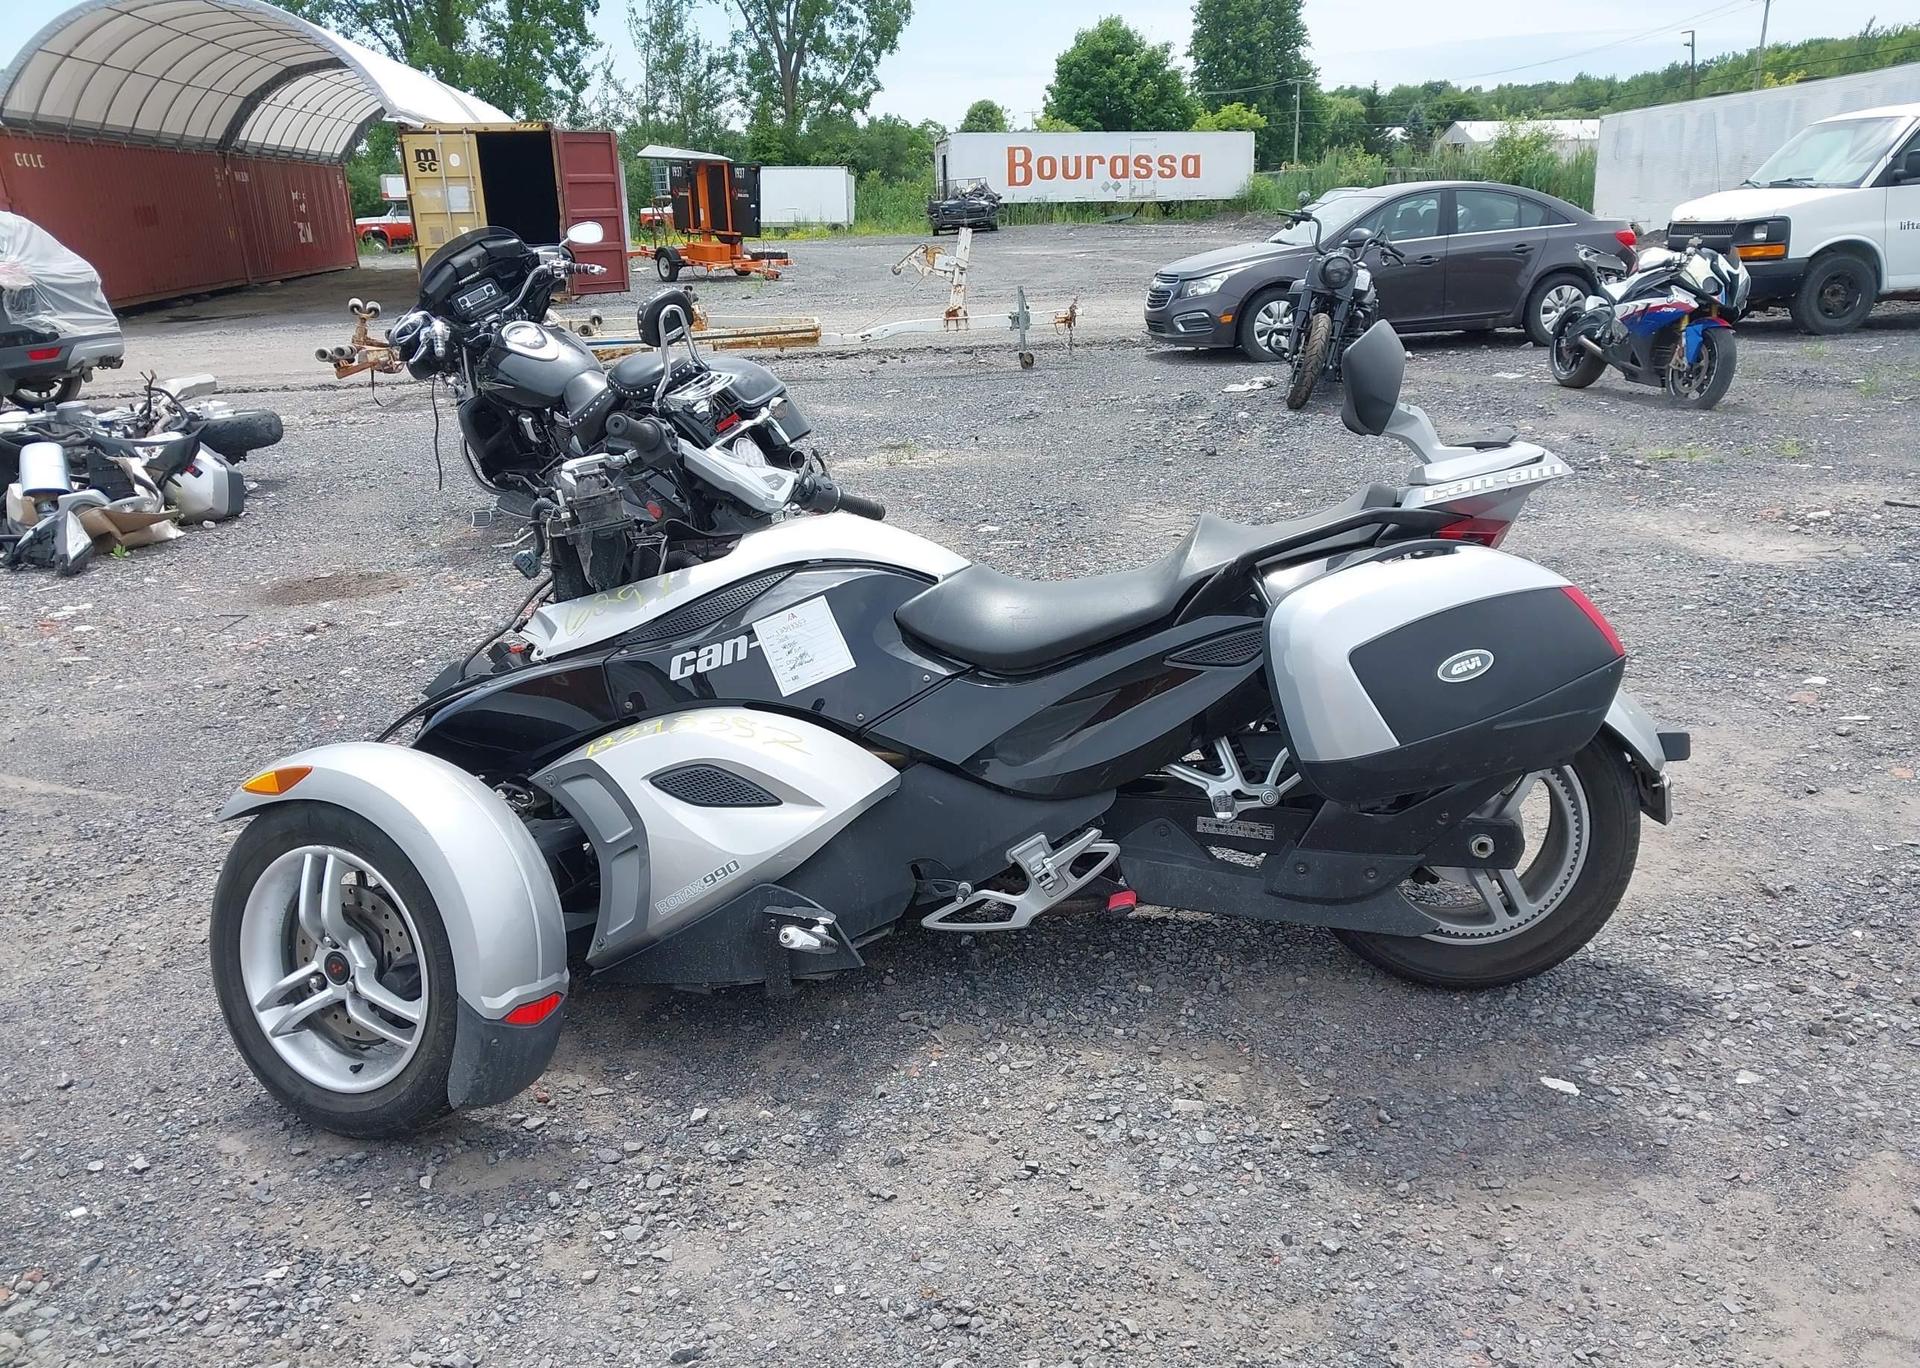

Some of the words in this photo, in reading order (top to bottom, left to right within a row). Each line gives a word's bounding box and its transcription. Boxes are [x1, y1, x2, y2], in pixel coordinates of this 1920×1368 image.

[1006, 145, 1201, 188] Bourassa
[1451, 655, 1482, 675] GIVI
[702, 858, 741, 889] 990
